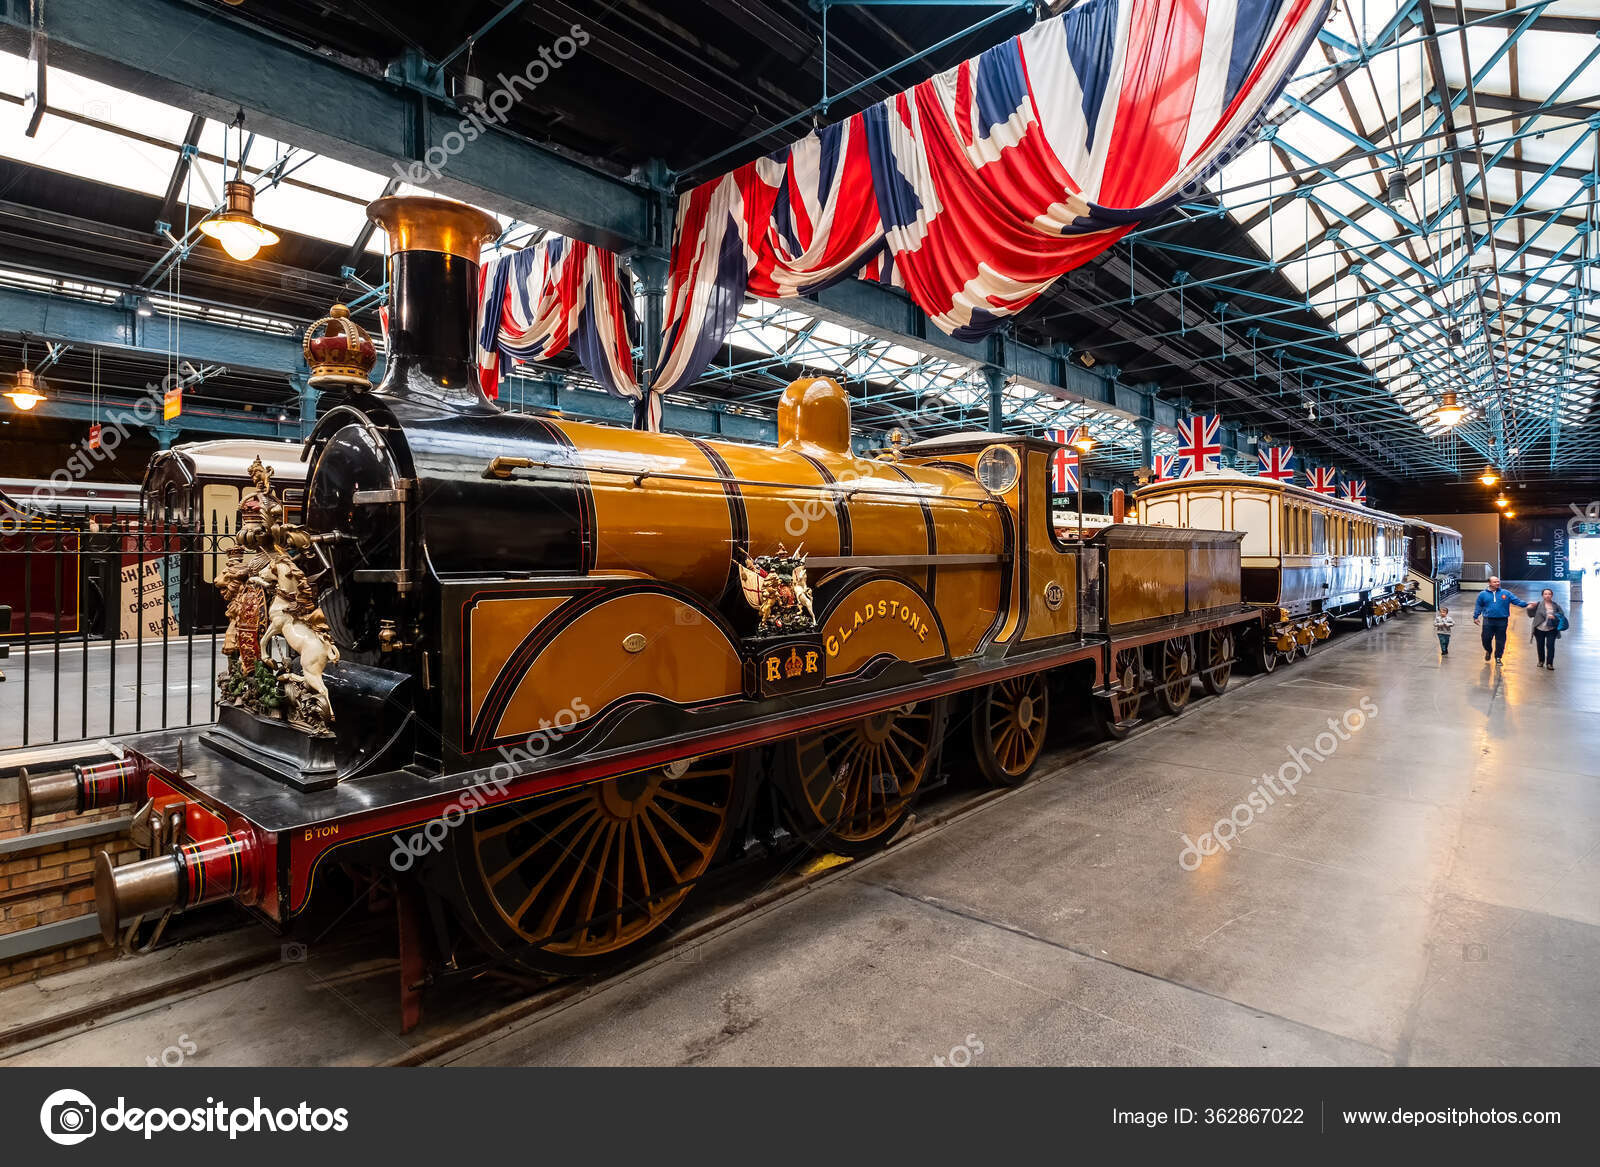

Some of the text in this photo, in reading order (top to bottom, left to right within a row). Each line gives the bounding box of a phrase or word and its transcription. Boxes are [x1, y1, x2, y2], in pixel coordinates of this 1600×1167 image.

[1554, 551, 1564, 578] SOUTH
[129, 598, 163, 613] Ceck
[826, 600, 929, 657] GLADSTONE
